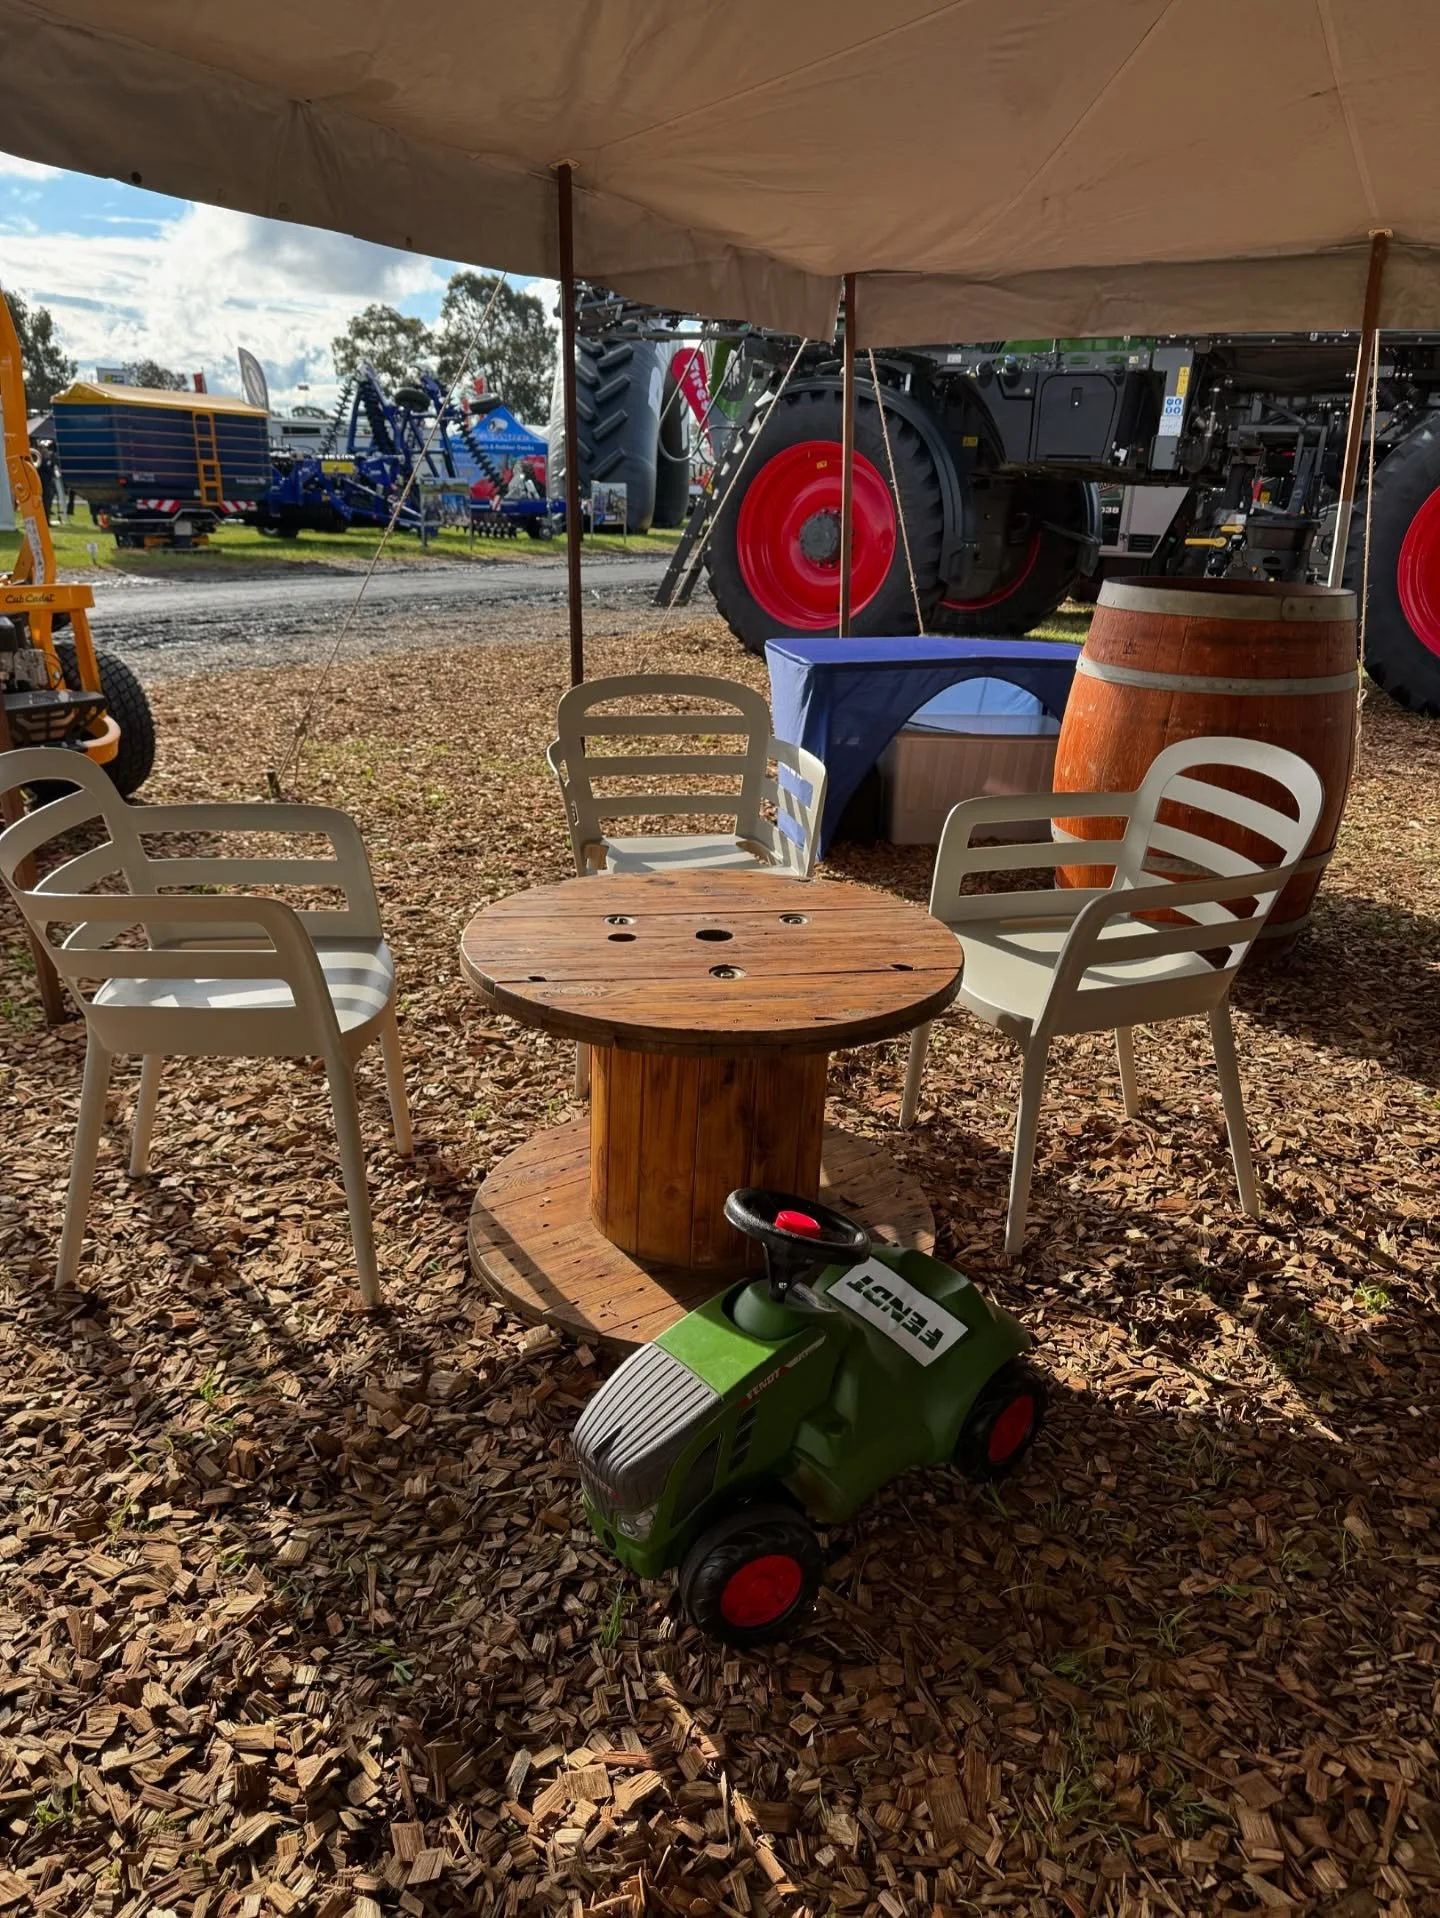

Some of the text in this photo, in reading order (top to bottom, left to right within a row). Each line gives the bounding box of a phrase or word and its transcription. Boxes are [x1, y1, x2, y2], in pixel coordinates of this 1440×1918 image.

[5, 592, 56, 603] Cub Cadet
[846, 1275, 944, 1351] FENDT
[746, 1367, 782, 1400] FENDT
